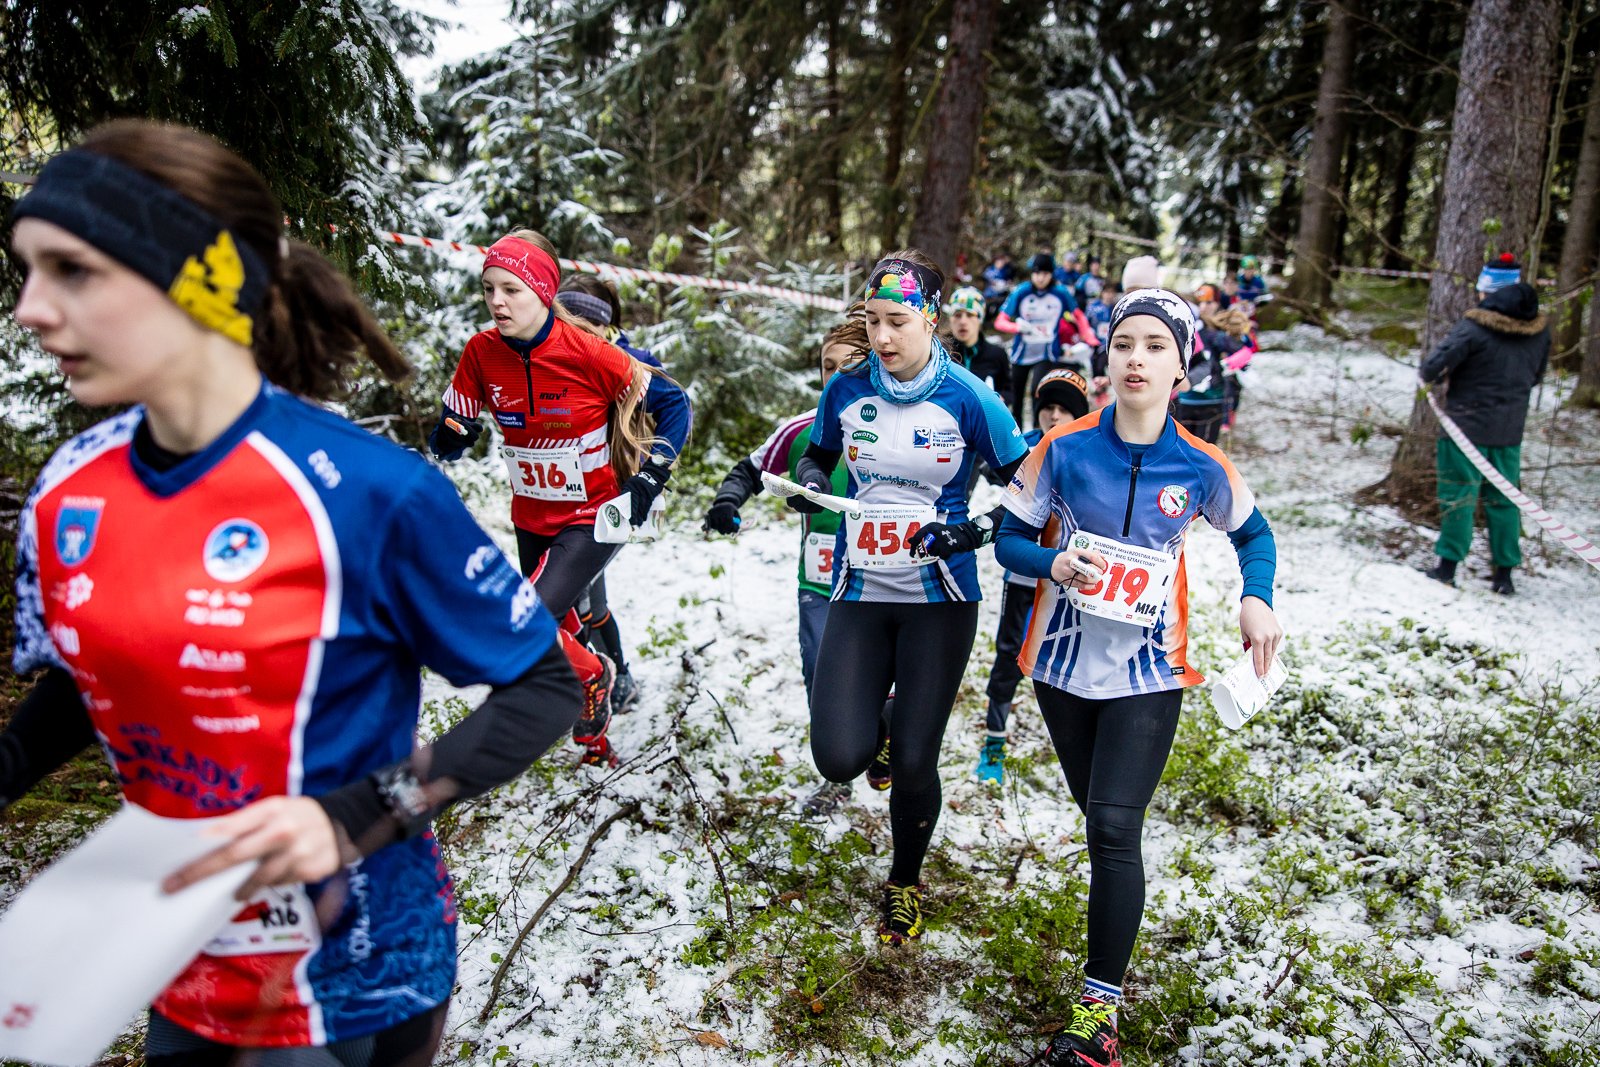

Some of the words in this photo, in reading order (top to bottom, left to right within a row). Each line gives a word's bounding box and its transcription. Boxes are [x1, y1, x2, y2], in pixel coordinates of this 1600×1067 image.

[517, 461, 567, 489] 316
[566, 483, 583, 492] M14
[1134, 602, 1158, 616] M14
[260, 905, 300, 928] K16
